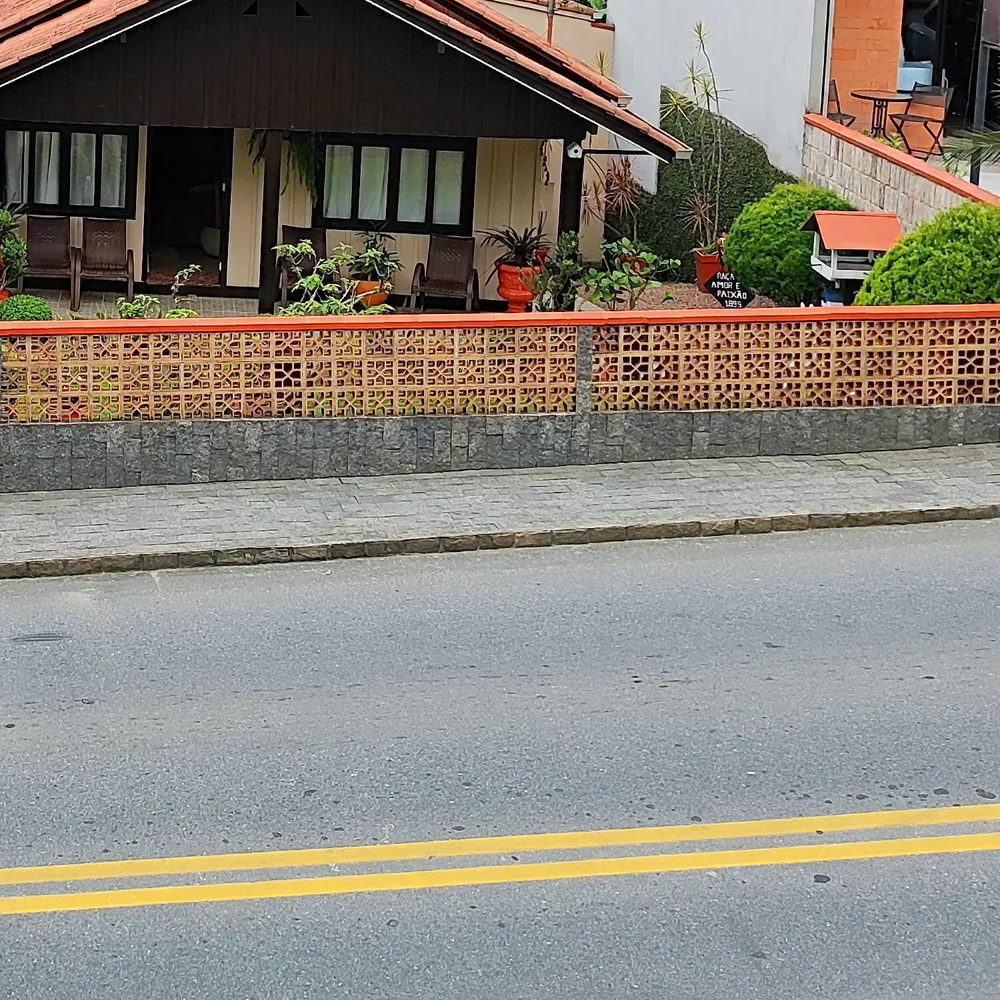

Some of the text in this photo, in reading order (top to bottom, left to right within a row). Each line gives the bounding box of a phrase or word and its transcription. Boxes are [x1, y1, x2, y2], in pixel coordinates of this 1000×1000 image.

[716, 271, 735, 281] RAÇA
[711, 281, 741, 290] AMOR E
[716, 290, 747, 300] PAIXÃO
